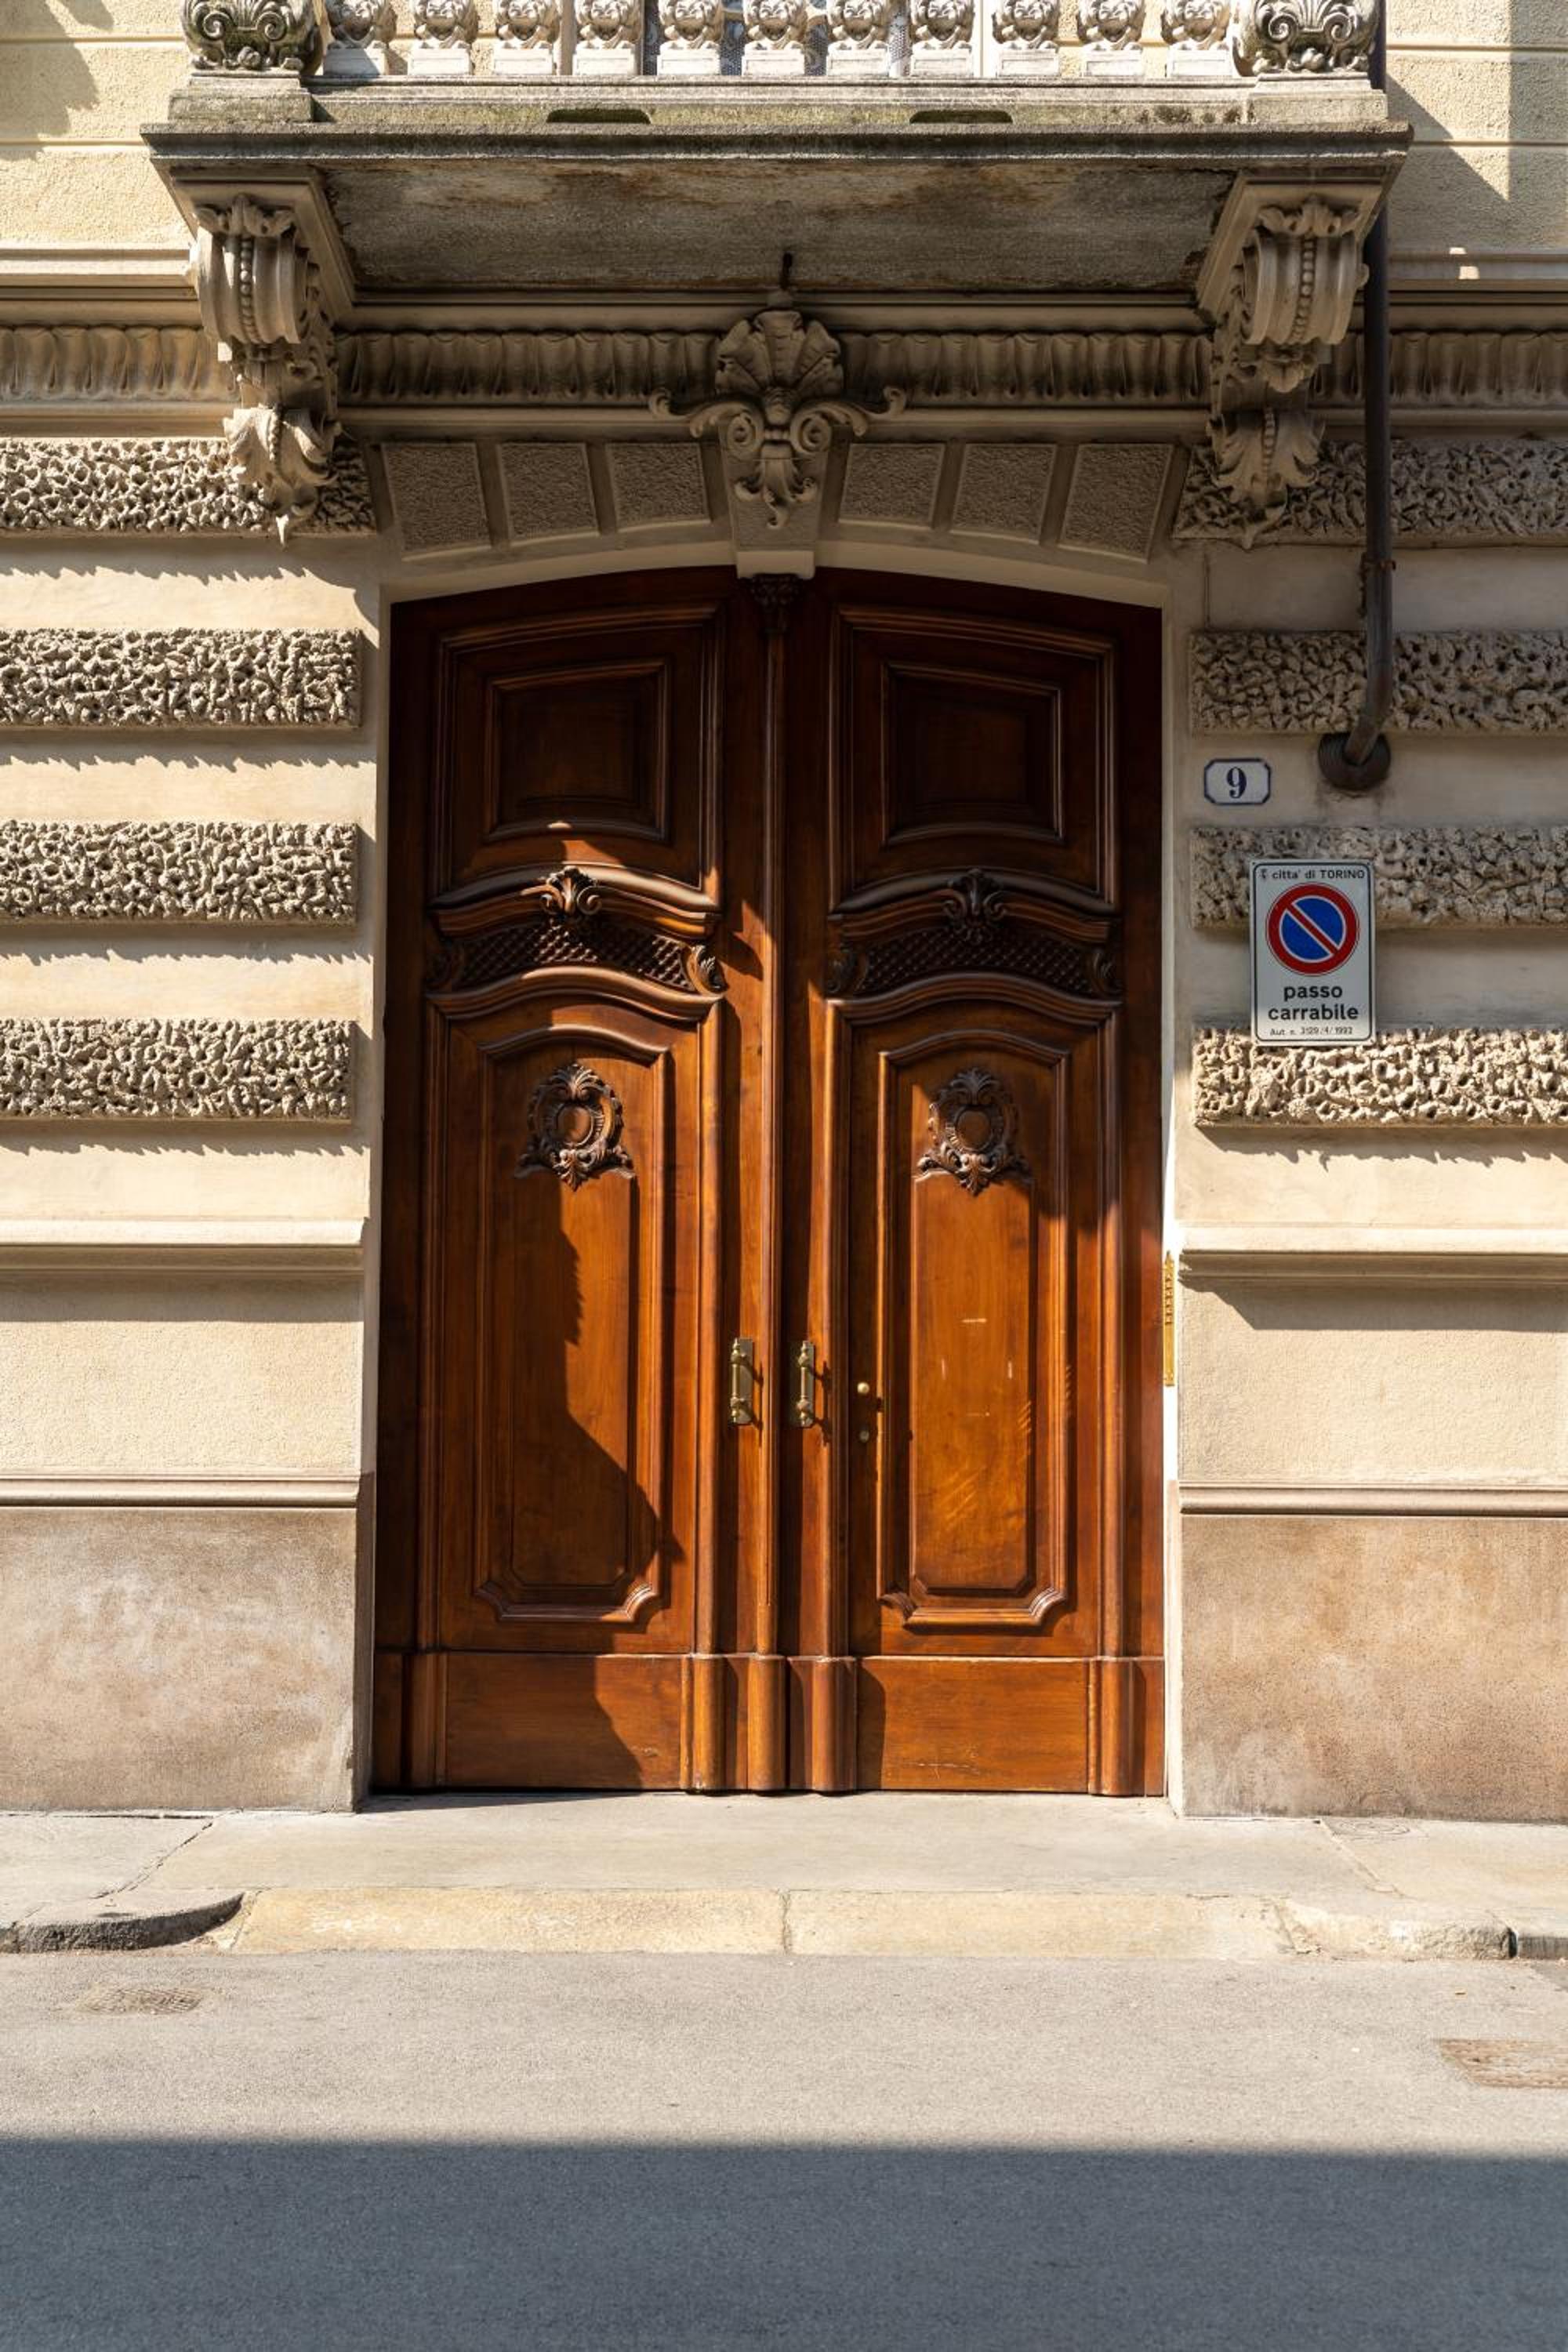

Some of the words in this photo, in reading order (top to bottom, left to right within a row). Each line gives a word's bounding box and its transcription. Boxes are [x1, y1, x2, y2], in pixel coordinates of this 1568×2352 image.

[1226, 766, 1247, 799] 9
[1305, 869, 1315, 879] di
[1319, 869, 1365, 879] TORINO
[1283, 985, 1343, 1002] passo
[1268, 1004, 1359, 1020] carrabile
